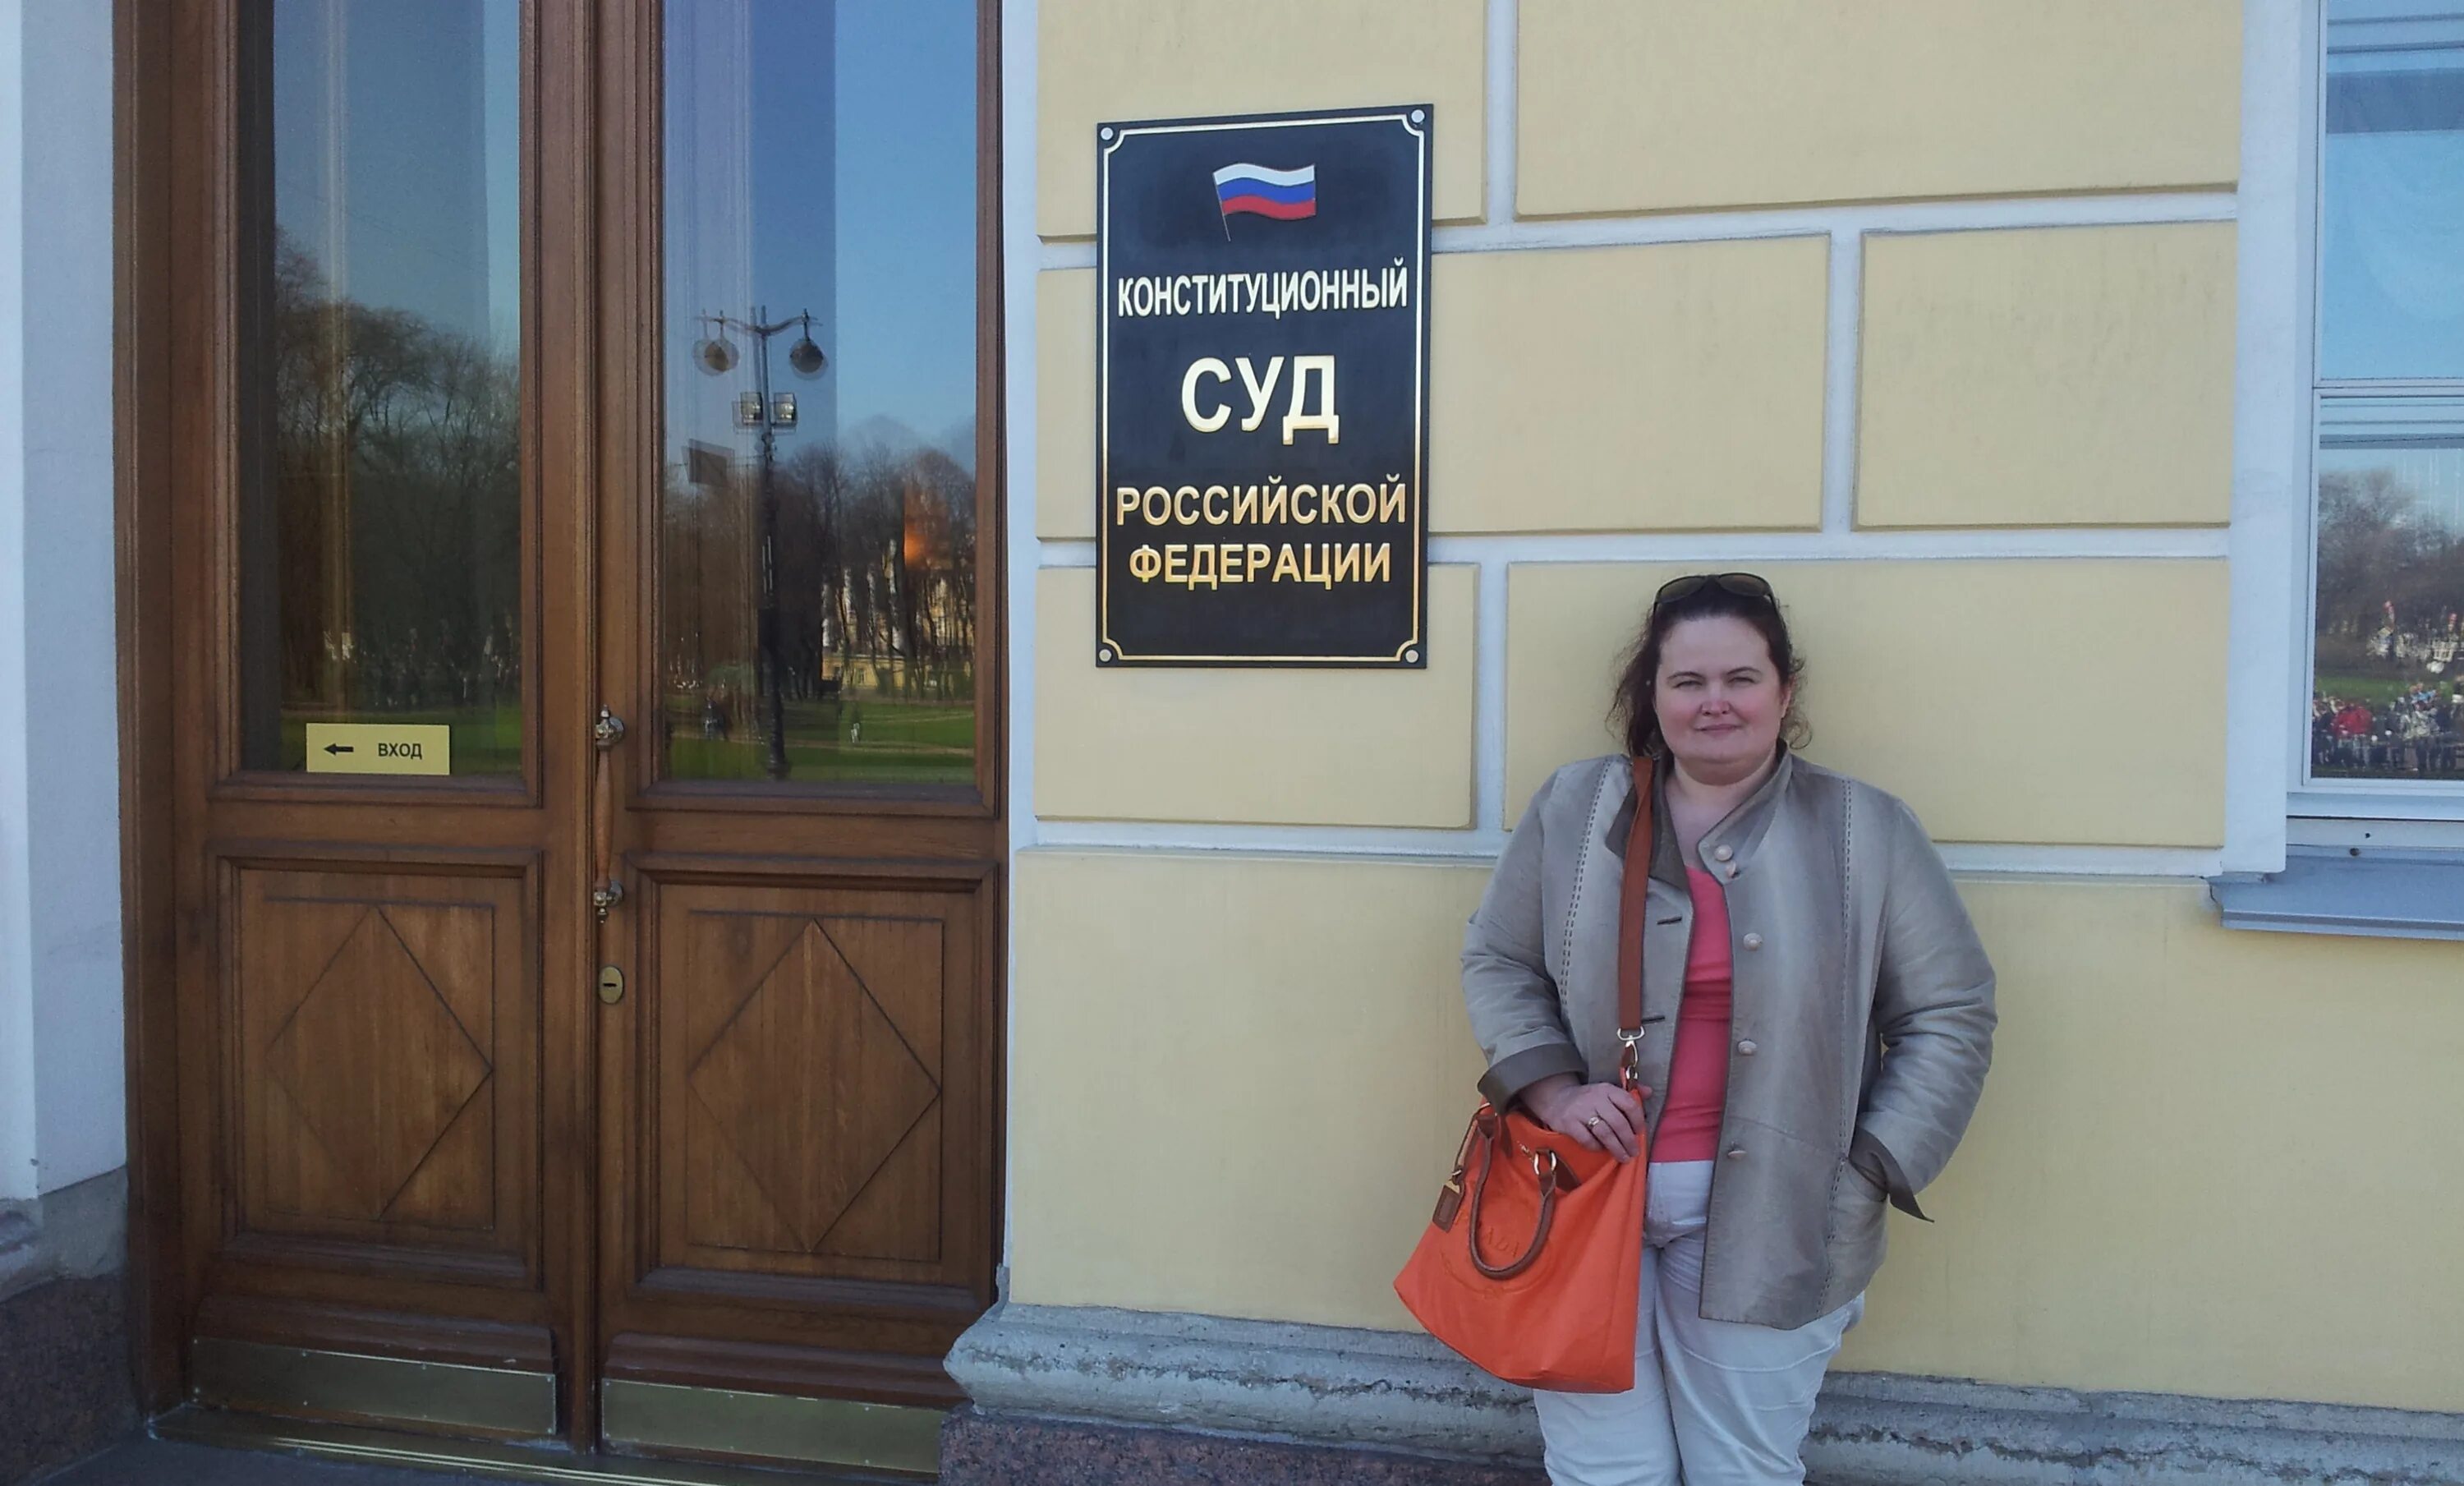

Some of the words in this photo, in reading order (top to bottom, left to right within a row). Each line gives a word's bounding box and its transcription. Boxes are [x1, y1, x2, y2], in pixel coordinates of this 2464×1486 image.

[1117, 257, 1408, 320] КОНСТИТУЦИОННЫЙ
[1181, 356, 1340, 445] СУД
[1116, 473, 1406, 527] РОССИЙСКОЙ
[1129, 542, 1391, 591] ФЕДЕРАЦИИ
[378, 743, 422, 760] ВХОД
